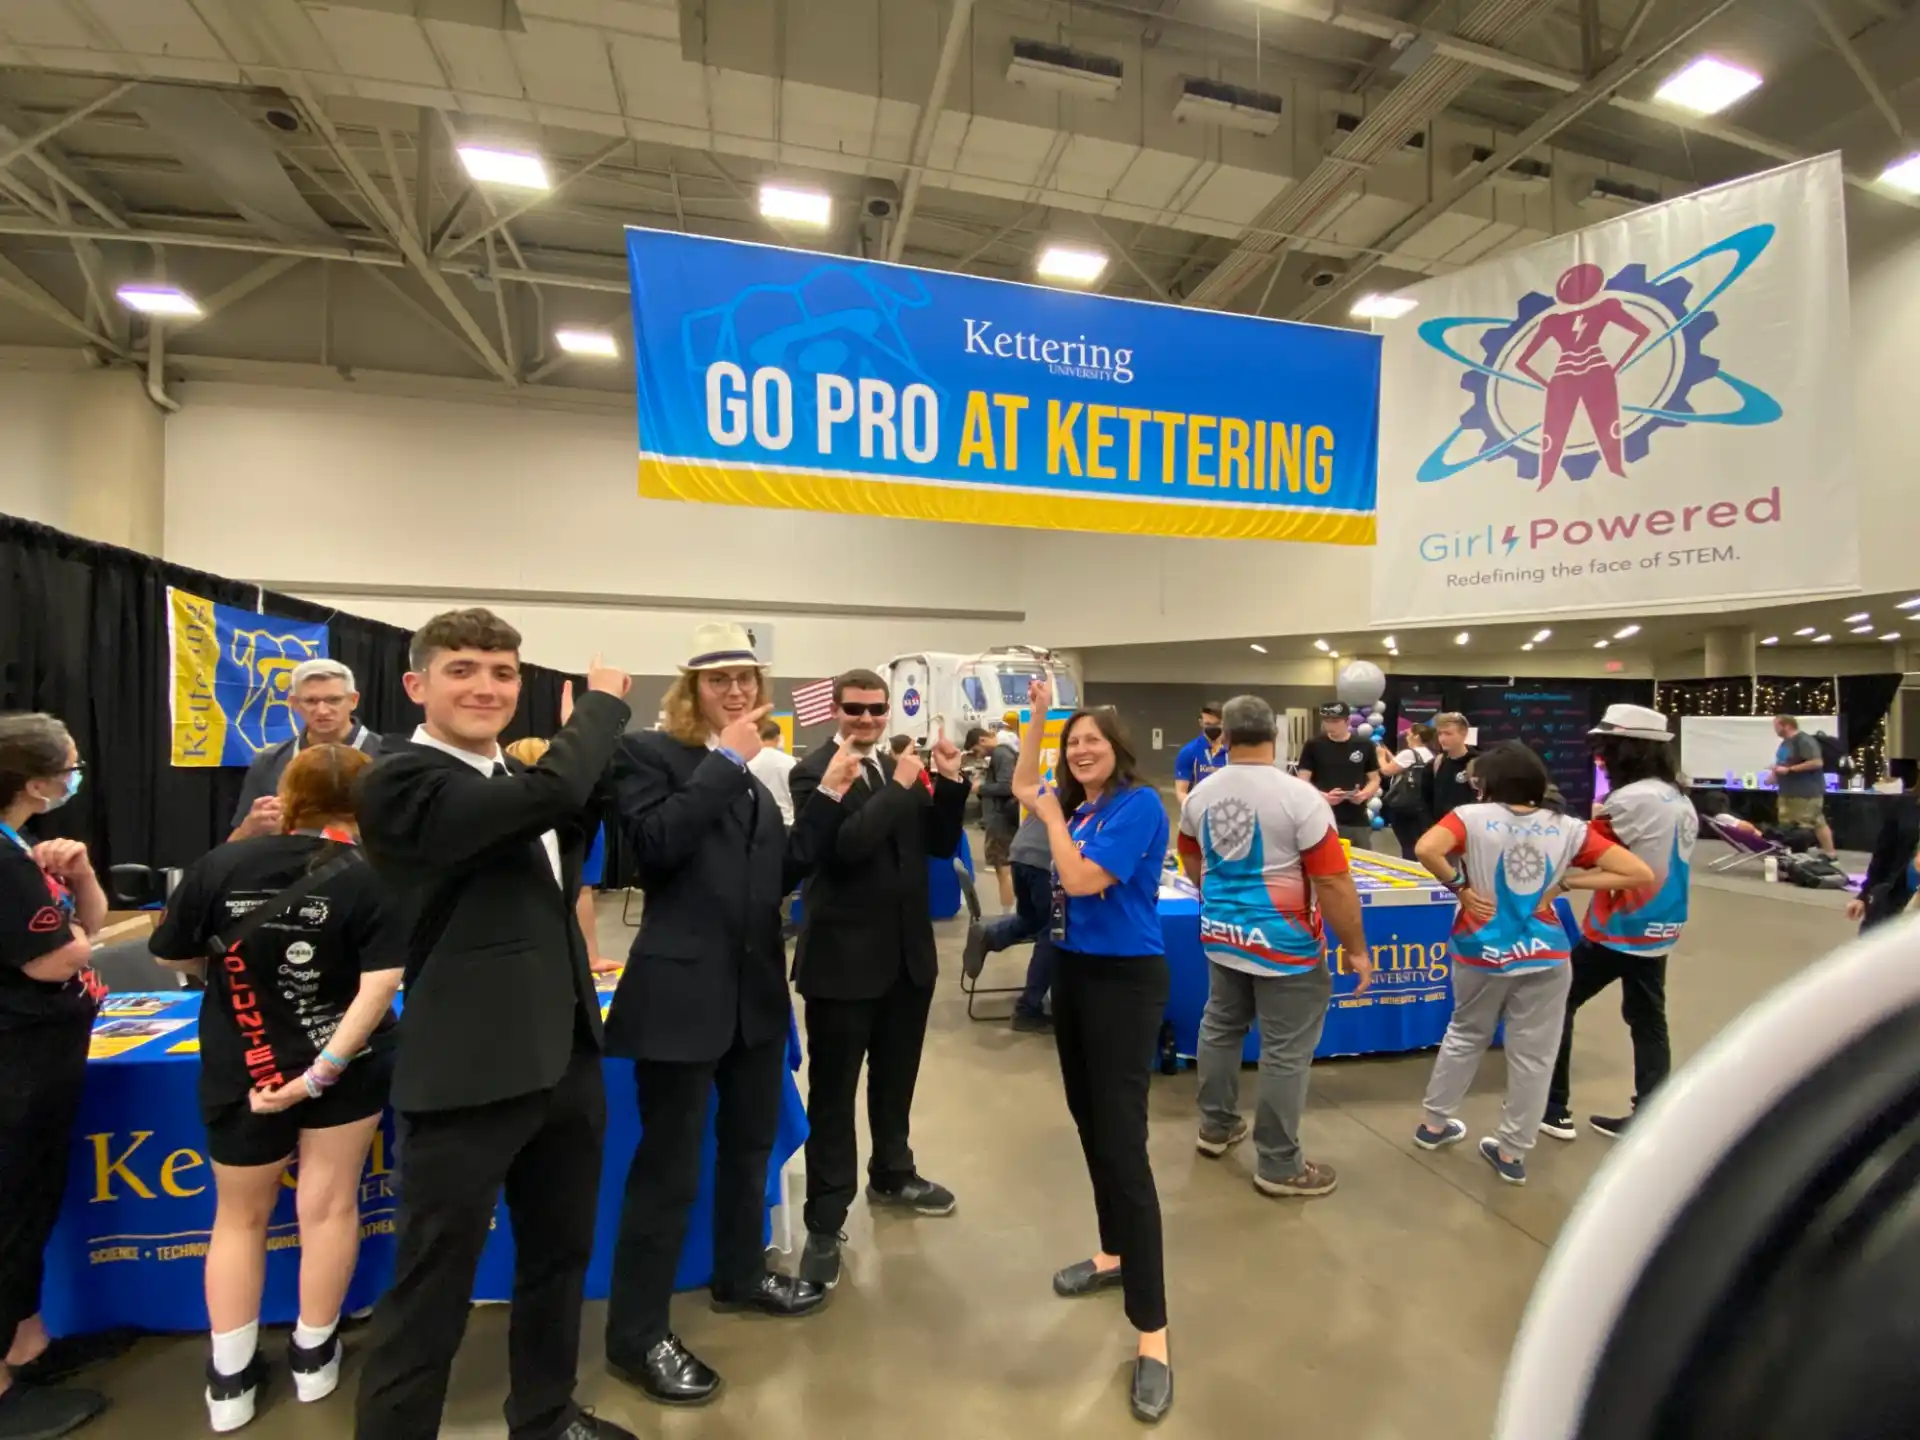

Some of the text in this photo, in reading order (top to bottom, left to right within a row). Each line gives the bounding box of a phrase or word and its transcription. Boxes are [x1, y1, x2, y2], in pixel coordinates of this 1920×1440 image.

[963, 318, 1134, 384] Kettering
[1049, 363, 1113, 381] UNIVERSITY
[705, 360, 1334, 495] GO PRO AT KETTERING
[1420, 486, 1781, 562] Girl Powered
[1446, 545, 1741, 588] Redefining the face of STEM.
[1371, 970, 1427, 985] IVERSITY
[224, 938, 285, 1088] OLUNTEER
